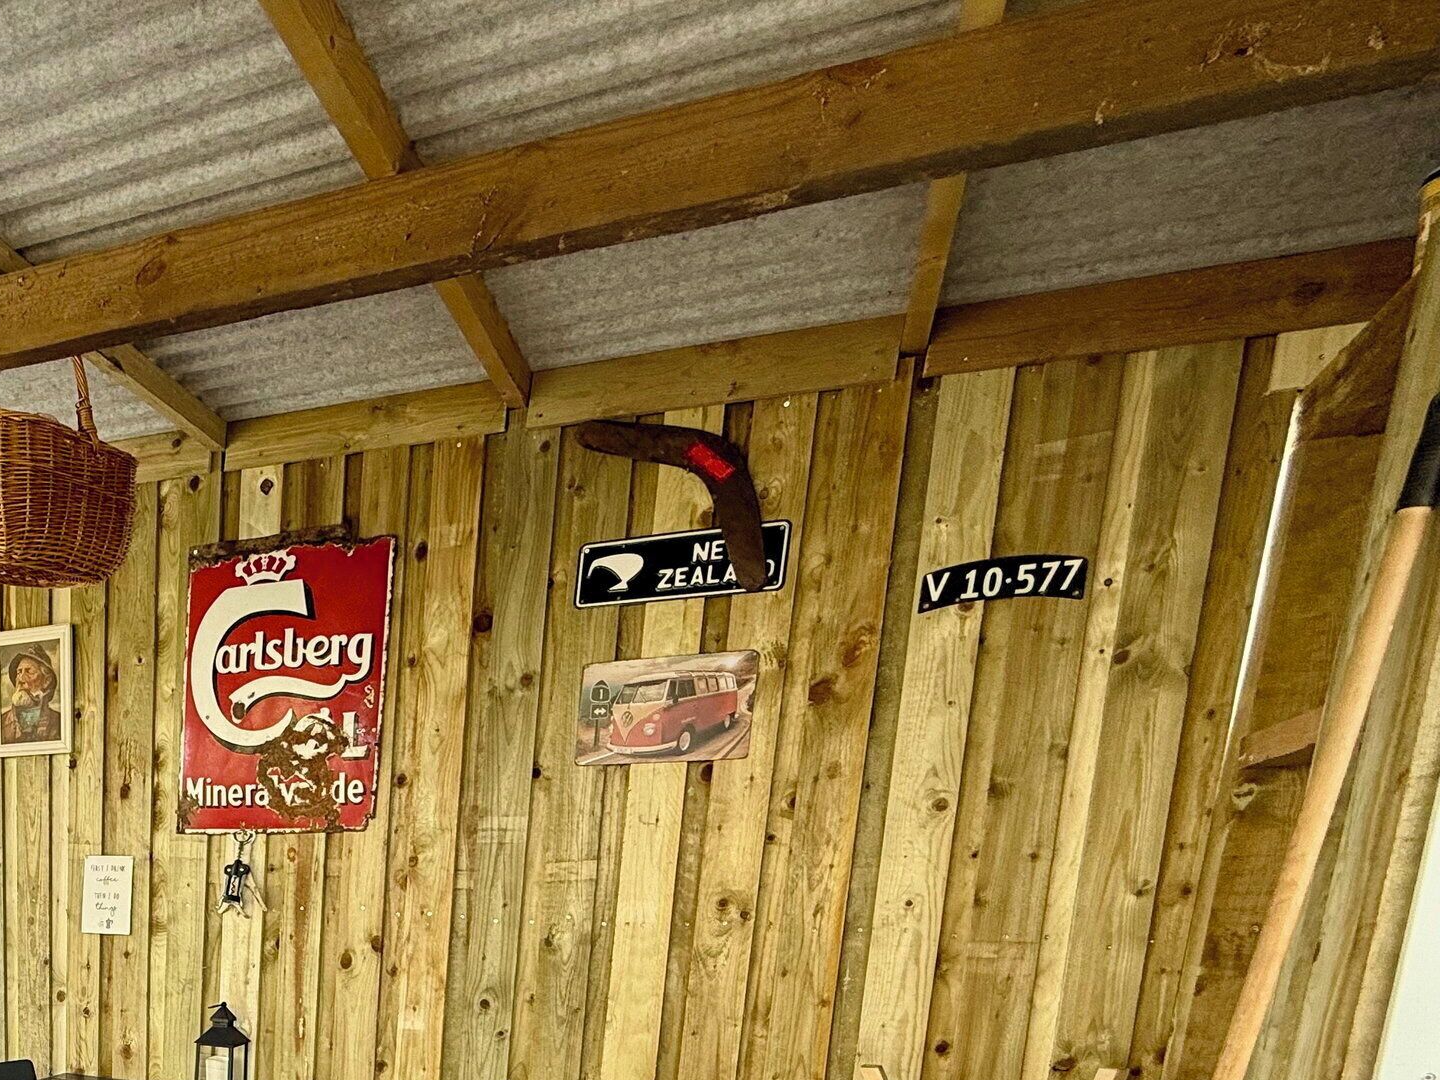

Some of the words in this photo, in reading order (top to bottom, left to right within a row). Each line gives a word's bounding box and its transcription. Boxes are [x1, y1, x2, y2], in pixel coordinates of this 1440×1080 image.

[691, 539, 725, 563] NE
[656, 559, 775, 590] ZEALAD
[926, 571, 951, 602] V
[191, 578, 374, 748] Carlsberg
